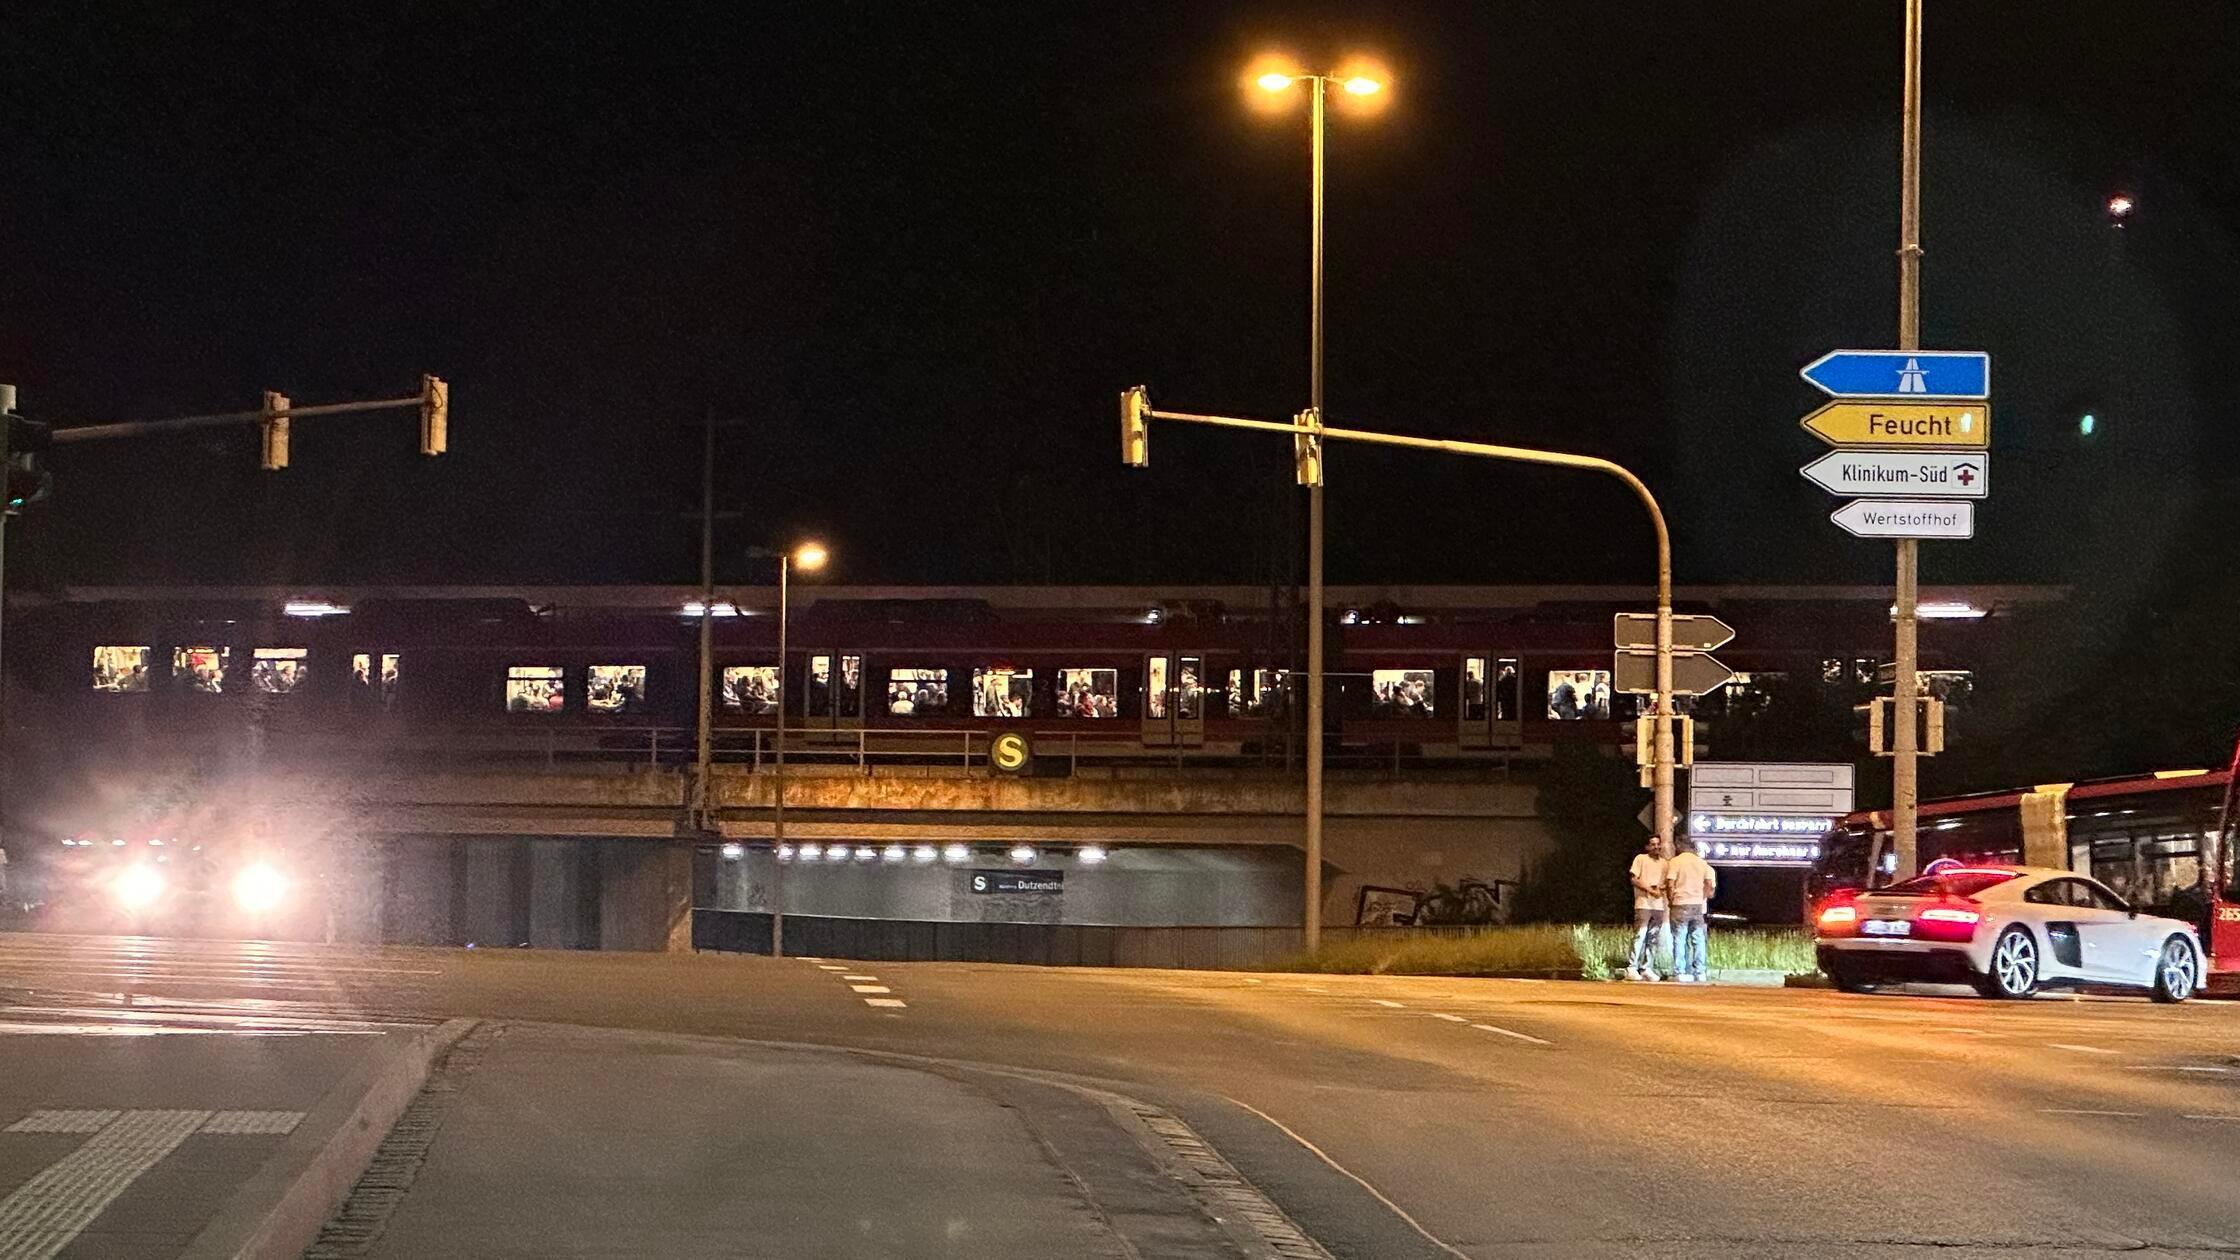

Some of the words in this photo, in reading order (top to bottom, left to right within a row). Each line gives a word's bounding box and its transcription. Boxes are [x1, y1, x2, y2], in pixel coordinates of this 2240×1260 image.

[1870, 414, 1952, 435] Feucht
[1842, 464, 1947, 483] Klinikum-Süd
[1863, 512, 1957, 526] Wertstoffhof
[999, 736, 1023, 767] S
[974, 876, 986, 891] S
